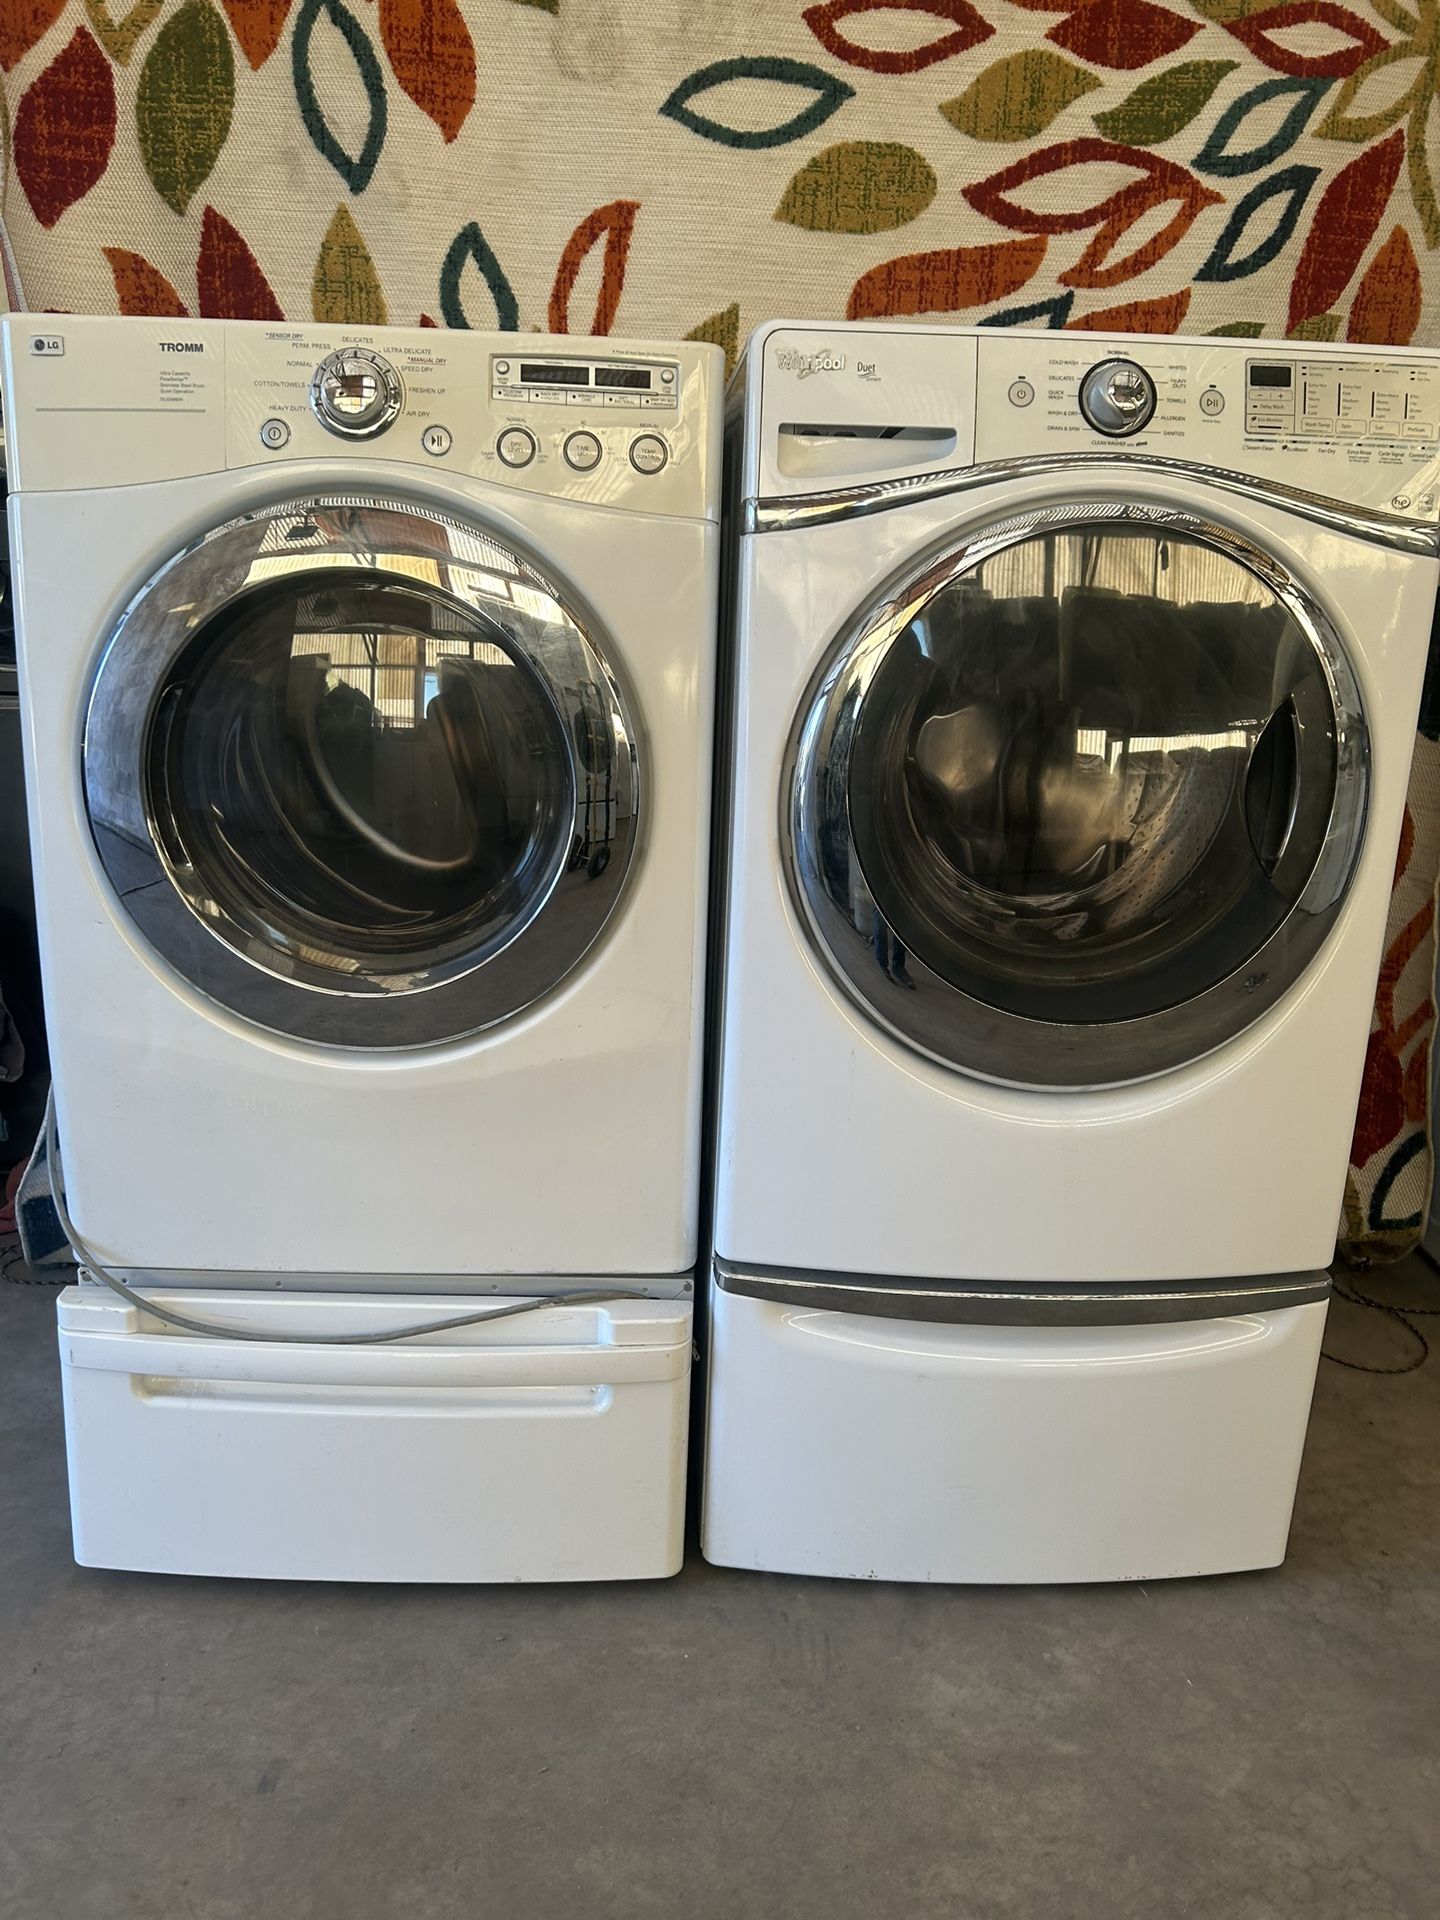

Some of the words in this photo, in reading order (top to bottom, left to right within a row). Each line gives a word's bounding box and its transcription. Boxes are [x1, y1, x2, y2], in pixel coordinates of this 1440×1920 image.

[342, 336, 374, 344] DELICATES
[47, 341, 59, 349] LG
[159, 343, 204, 352] TROMM
[404, 347, 431, 355] DELICATE
[775, 349, 846, 374] Whirlpool
[857, 361, 876, 372] Duet
[254, 380, 306, 388] COTTON/TOWELS
